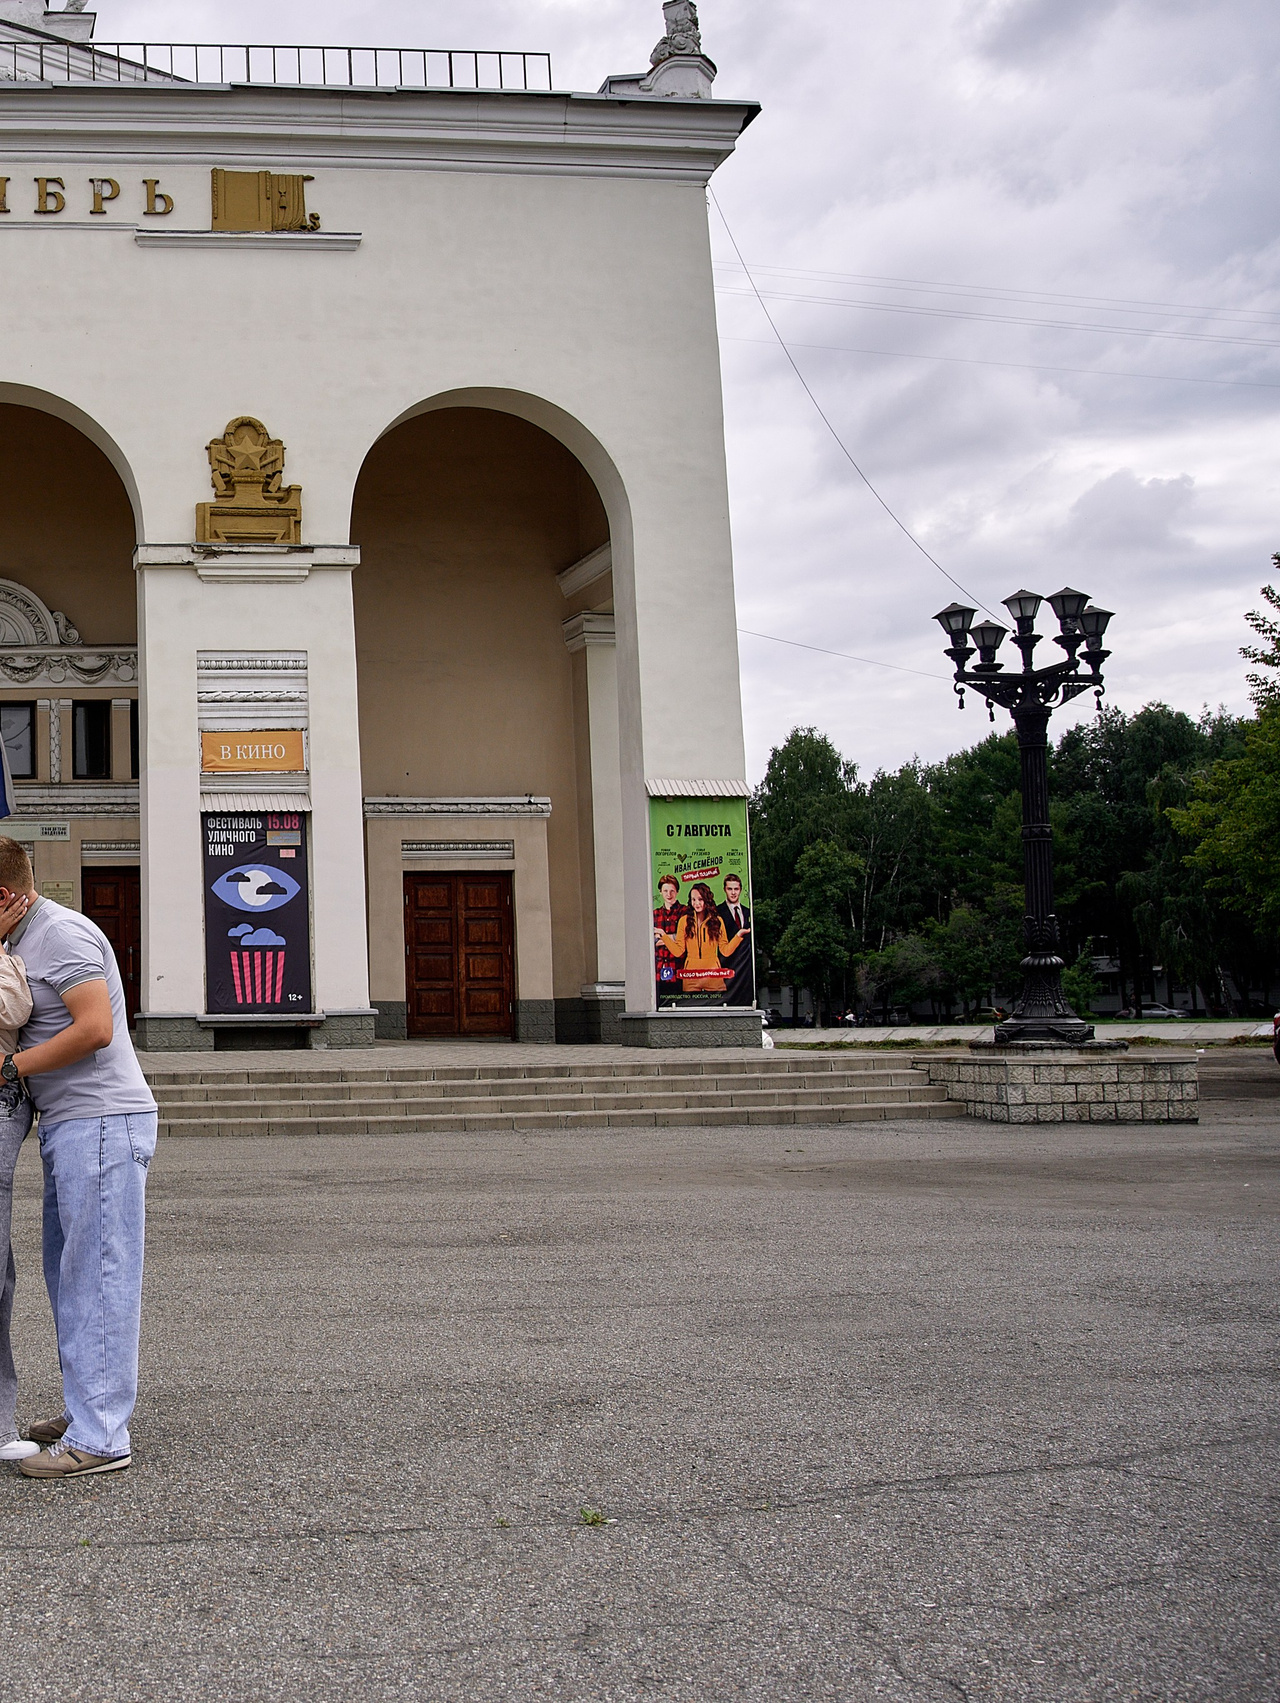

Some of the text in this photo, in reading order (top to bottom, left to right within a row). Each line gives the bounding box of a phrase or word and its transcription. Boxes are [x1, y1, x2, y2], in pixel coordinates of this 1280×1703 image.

[220, 744, 286, 760] В КИНО
[207, 817, 263, 829] ФЕСТИВАЛЬ
[266, 813, 299, 829] 15.08
[208, 830, 256, 843] УЛИЧНОГО
[666, 824, 731, 837] С 7 АВГУСТА
[208, 844, 234, 856] КИНО
[674, 862, 692, 874] ИВАН
[692, 855, 724, 871] СЕМЁНОВ
[663, 967, 671, 978] 6+
[288, 993, 303, 1001] 12+
